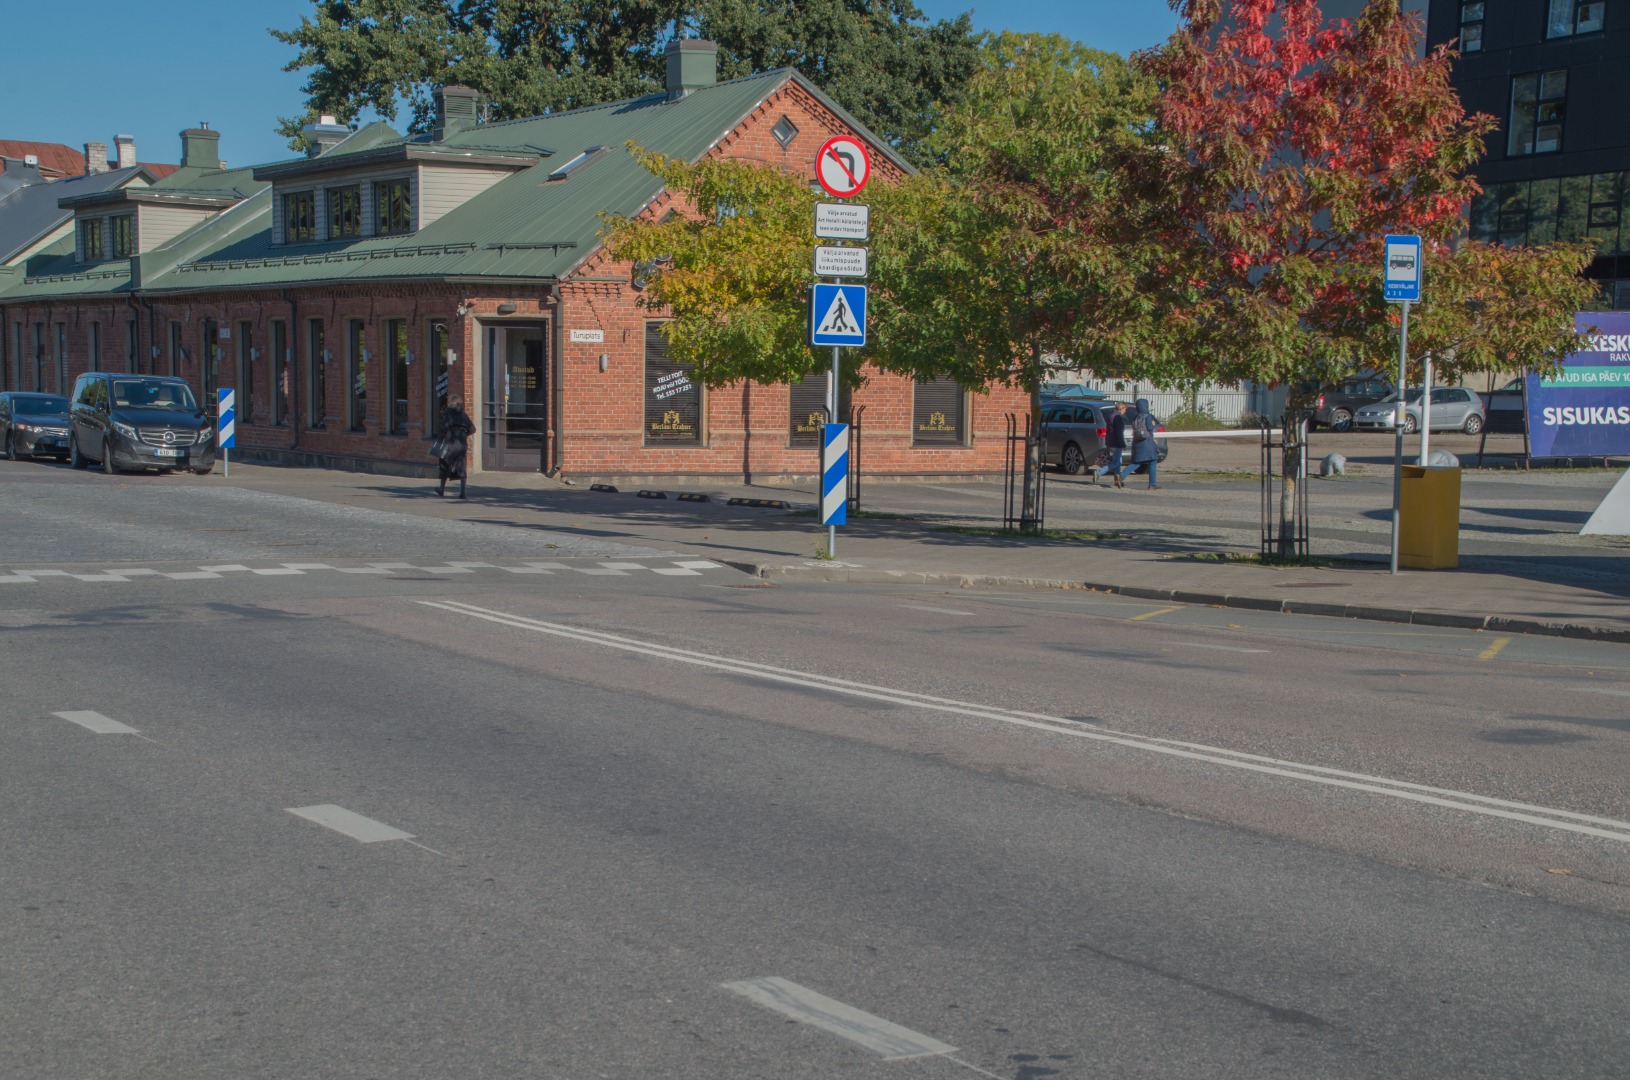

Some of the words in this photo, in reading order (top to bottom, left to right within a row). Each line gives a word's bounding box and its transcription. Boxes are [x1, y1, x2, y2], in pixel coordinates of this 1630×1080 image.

[819, 265, 843, 273] kaardiga
[573, 332, 600, 340] Turuplats
[657, 374, 671, 384] TELLI
[1582, 373, 1597, 382] IGA
[1600, 371, 1620, 382] PÄEV
[653, 384, 666, 393] KOJU
[1543, 407, 1630, 425] SISUKAS
